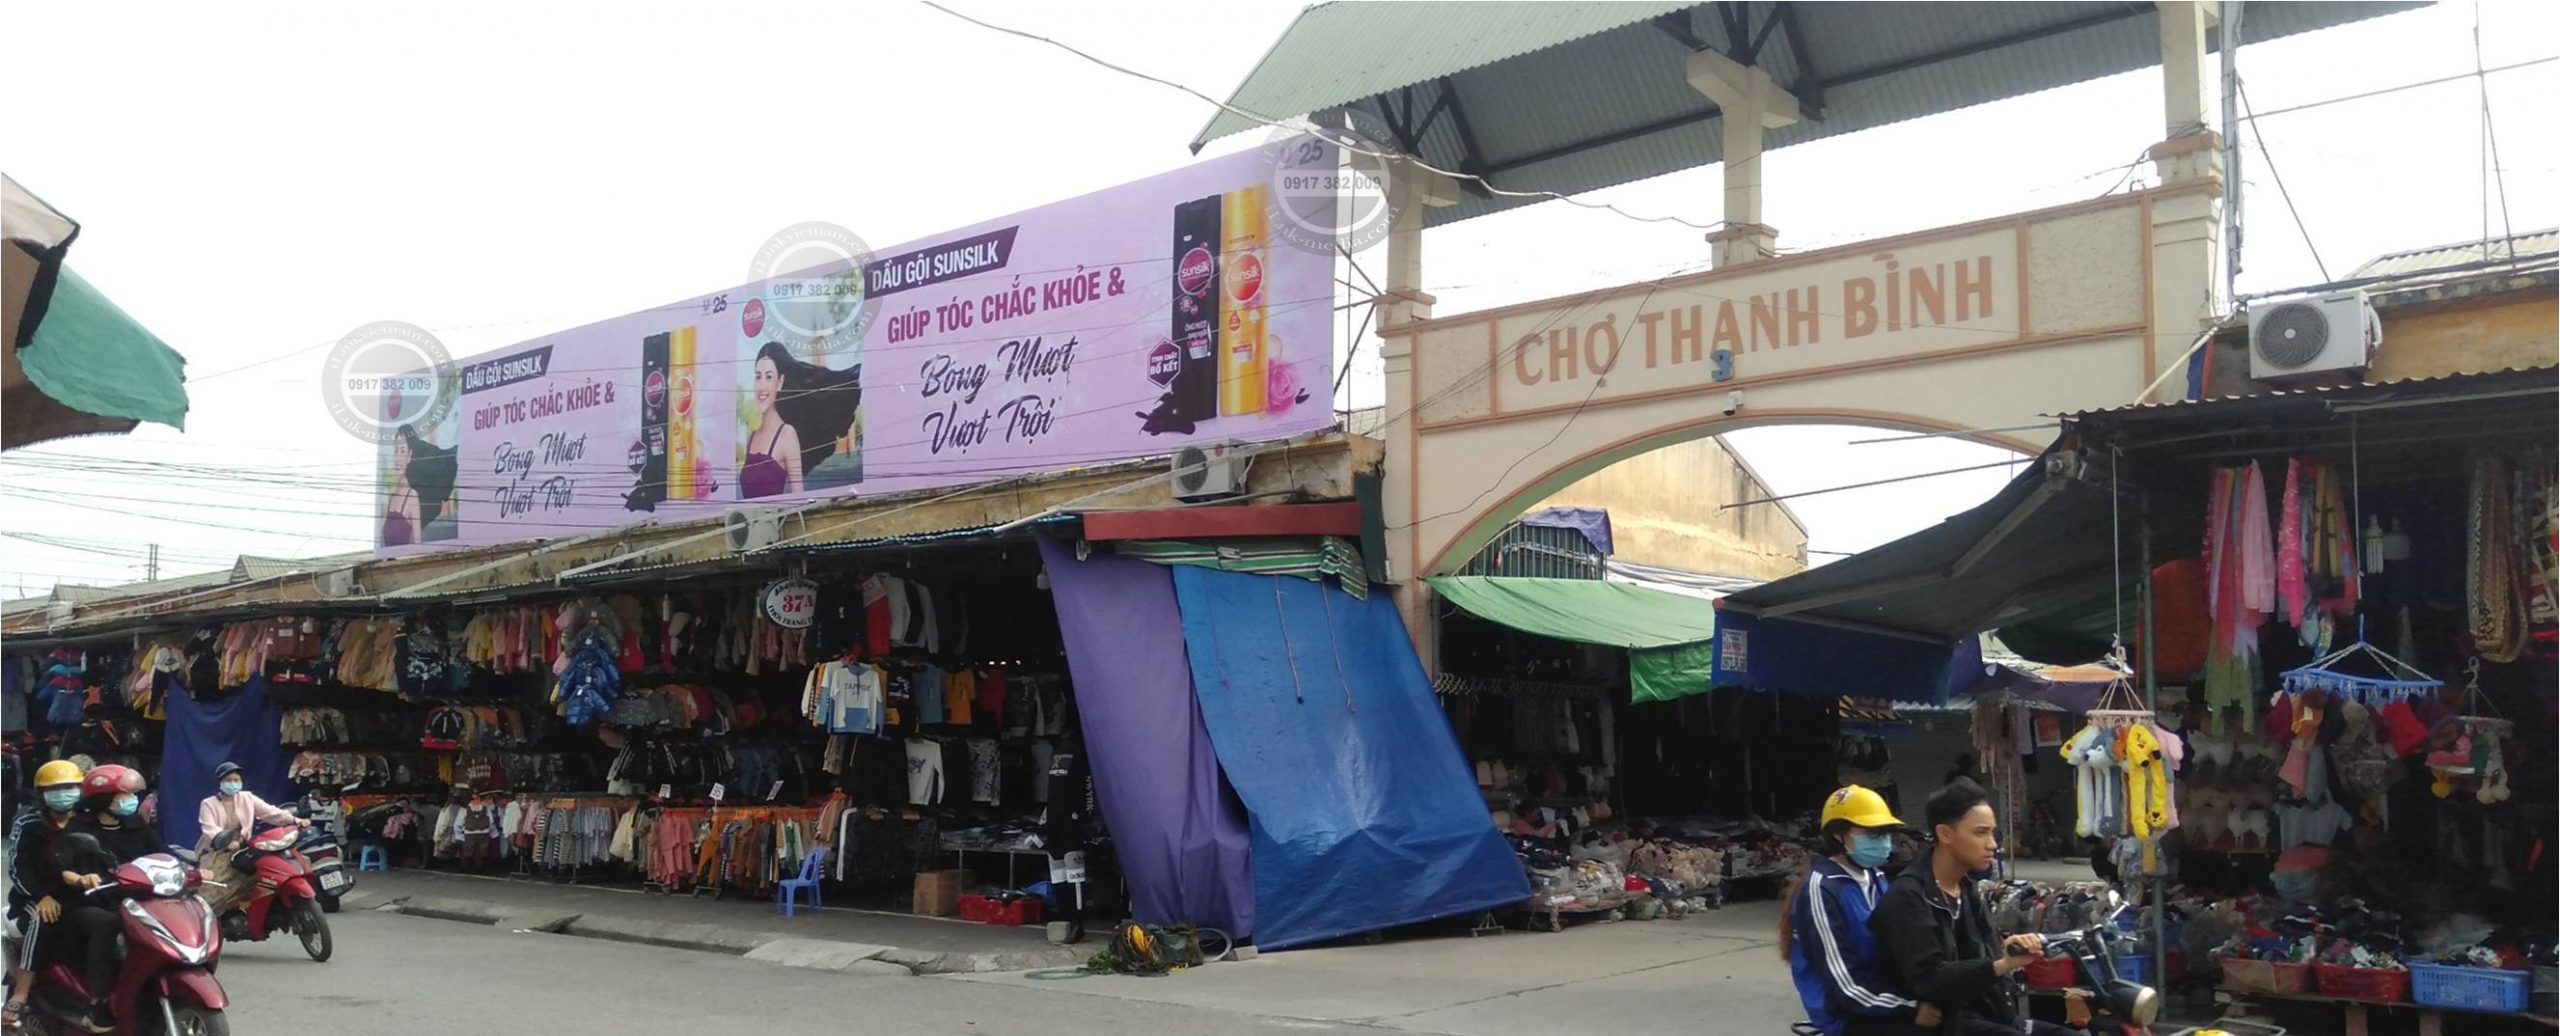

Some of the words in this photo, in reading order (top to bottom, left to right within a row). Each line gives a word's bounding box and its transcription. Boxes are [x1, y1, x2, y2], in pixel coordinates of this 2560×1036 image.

[1299, 140, 1323, 166] 25
[872, 259, 902, 292] DẦU
[905, 253, 930, 287] GỘI
[934, 240, 999, 278] SUNSILK
[713, 294, 728, 314] 25
[887, 306, 931, 344] GIÚP
[936, 296, 974, 334] TÓC
[981, 275, 1036, 325] CHẮC
[1043, 264, 1101, 311] KHỎE
[1107, 267, 1125, 297] &
[1515, 312, 1620, 388] CHỢ
[1637, 284, 1821, 370] THANH
[1843, 252, 1995, 341] BÌNH
[486, 362, 501, 387] GỘI
[503, 354, 542, 381] SUNSILK
[921, 354, 990, 404] Bóng
[997, 335, 1079, 383] Mượt
[1711, 349, 1735, 382] 3
[474, 402, 500, 431] GIÚP
[504, 397, 526, 425] TÓC
[530, 382, 563, 419] CHẮC
[567, 377, 601, 411] KHỎE
[604, 381, 615, 403] &
[922, 401, 992, 455] Vượt
[998, 395, 1056, 445] Trội
[494, 478, 537, 519] Vượt
[782, 594, 815, 613] 37A
